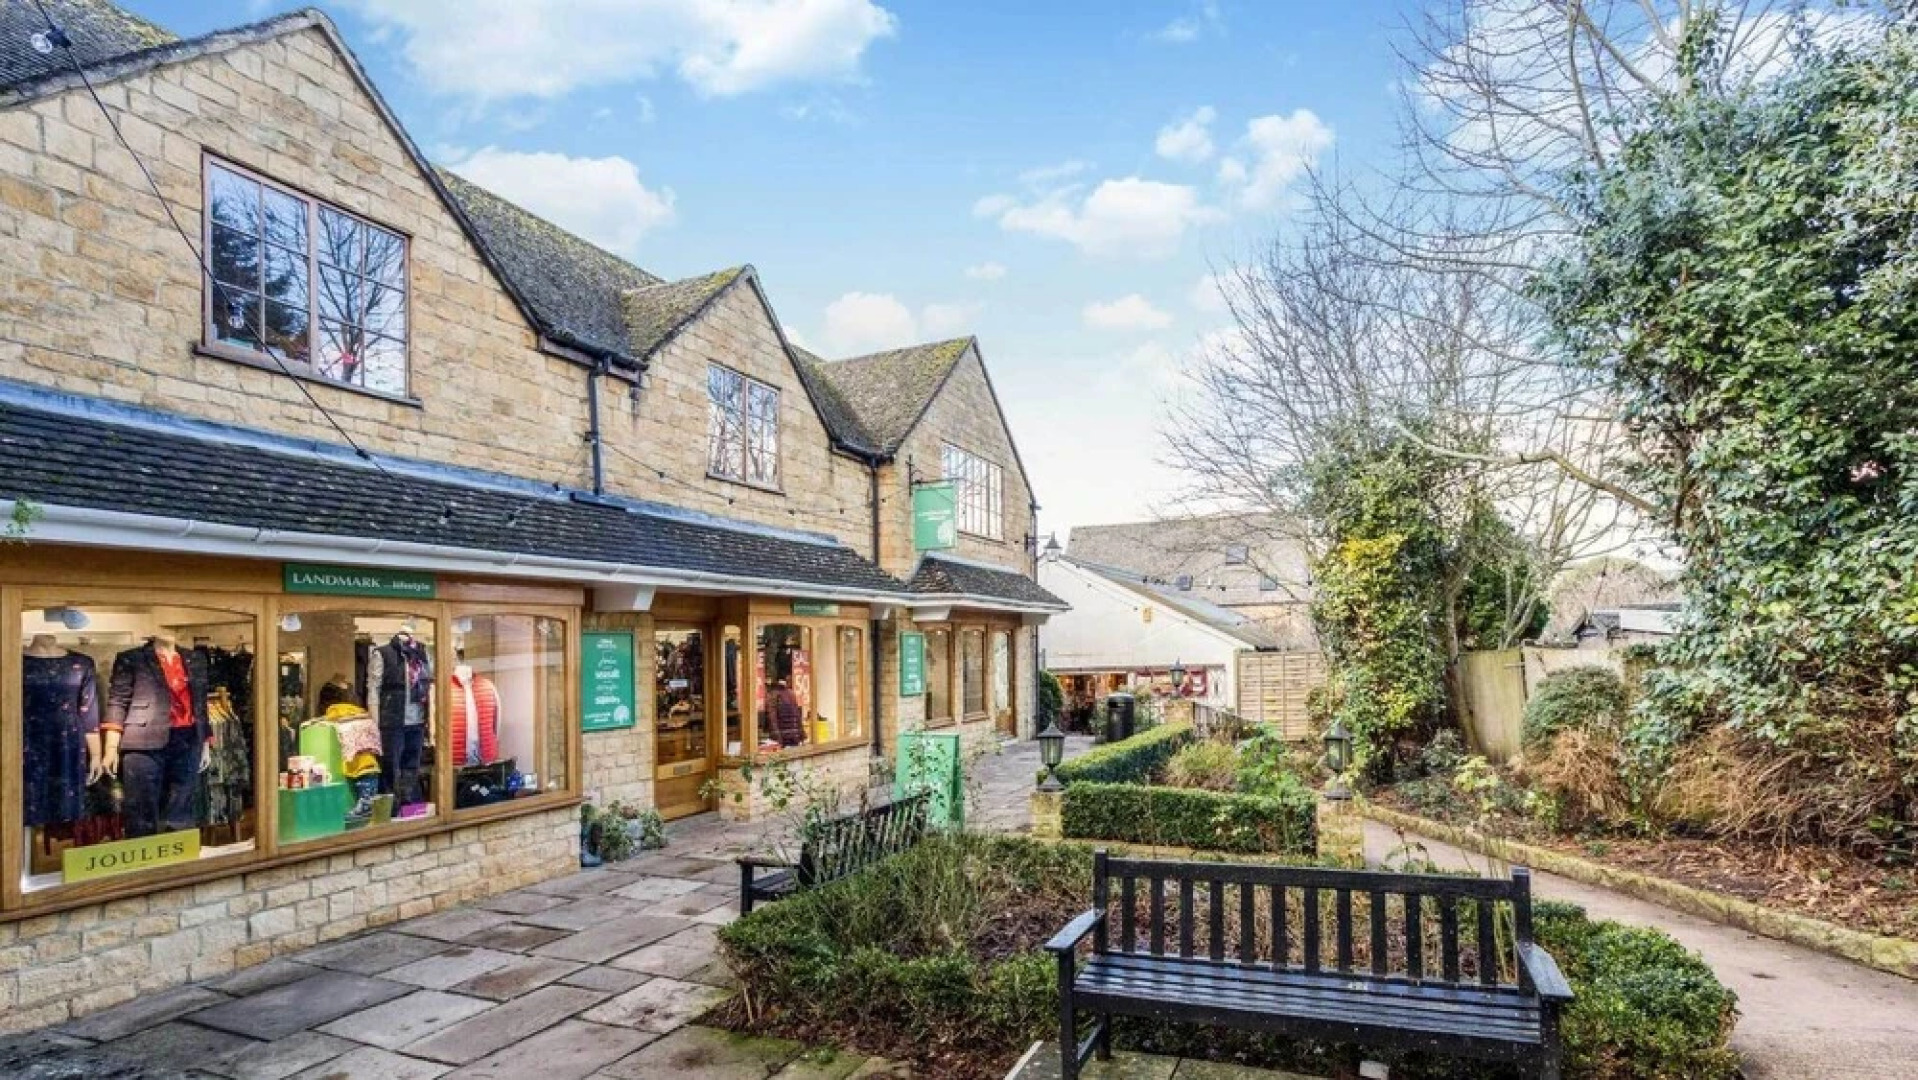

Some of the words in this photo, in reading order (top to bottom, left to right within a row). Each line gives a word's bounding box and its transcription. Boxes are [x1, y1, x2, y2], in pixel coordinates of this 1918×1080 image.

[293, 573, 381, 588] LANDMARK
[793, 651, 810, 666] SAL
[86, 842, 185, 872] JOULES
